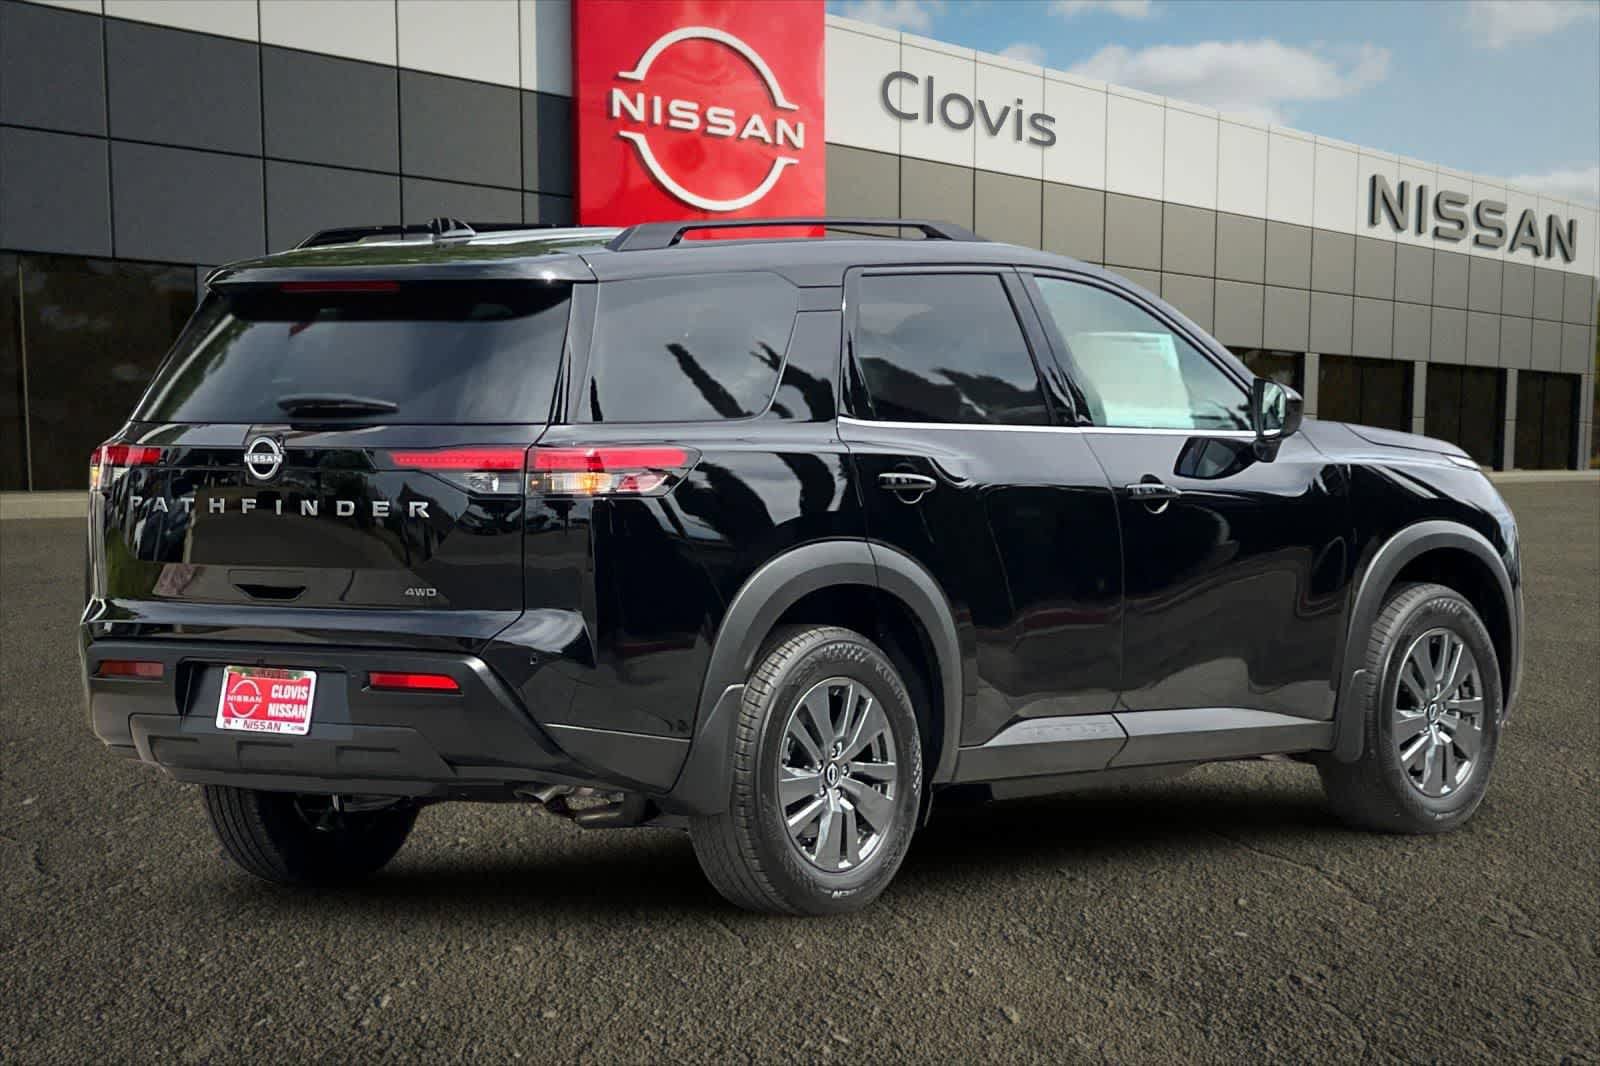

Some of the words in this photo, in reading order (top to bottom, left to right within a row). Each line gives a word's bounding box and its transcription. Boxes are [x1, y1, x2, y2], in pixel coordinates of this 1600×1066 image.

[881, 71, 1057, 147] Clovis
[610, 88, 805, 149] NISSAN
[1368, 173, 1578, 264] NISSAN
[243, 453, 283, 465] NISSAN
[129, 495, 430, 518] PATHFINDER
[404, 587, 437, 597] 4WD
[271, 684, 309, 701] CLOVIS
[267, 702, 308, 719] NISSAN
[242, 719, 281, 732] NISSAN
